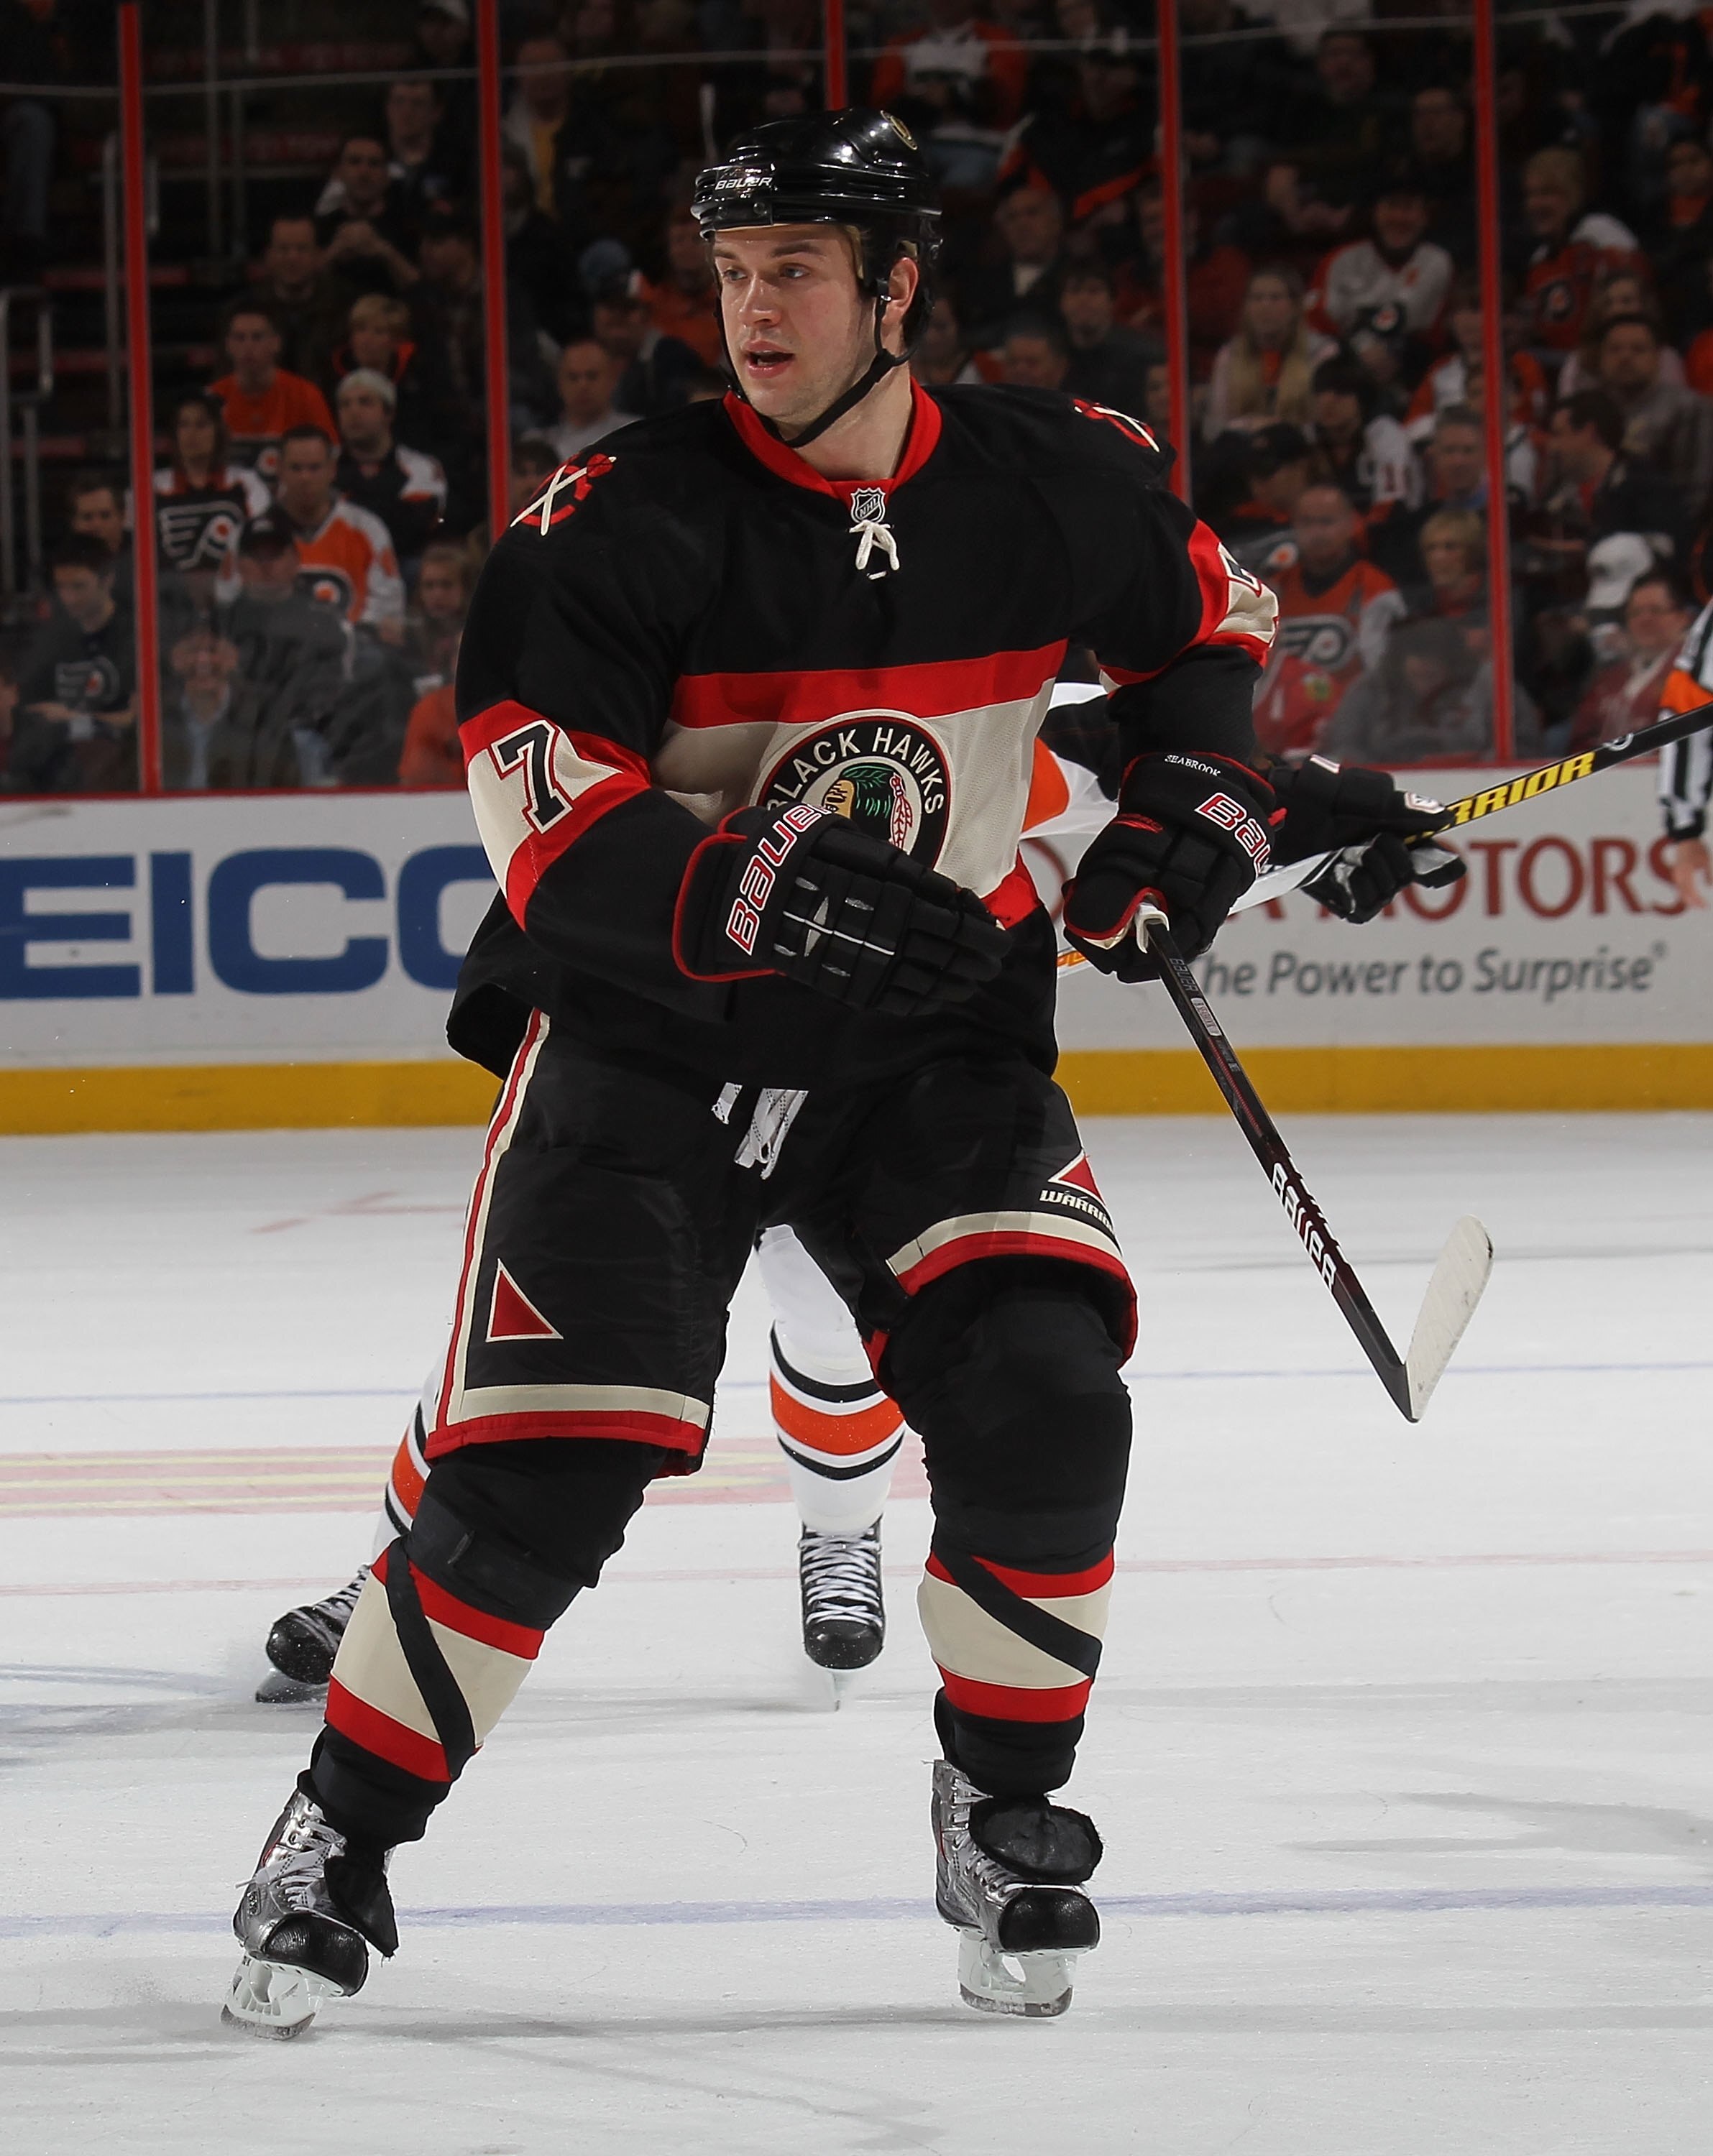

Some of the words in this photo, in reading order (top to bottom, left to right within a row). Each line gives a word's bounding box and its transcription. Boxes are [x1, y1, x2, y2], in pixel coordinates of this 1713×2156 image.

[859, 497, 879, 518] NHL
[490, 719, 574, 834] 7
[871, 727, 945, 814] HAWKS
[1164, 755, 1221, 777] SEABROOK
[1403, 751, 1596, 845] RRIOR
[1318, 834, 1688, 922] OTORS
[1190, 952, 1254, 994] he
[1268, 952, 1407, 995] Power
[1420, 954, 1465, 995] to
